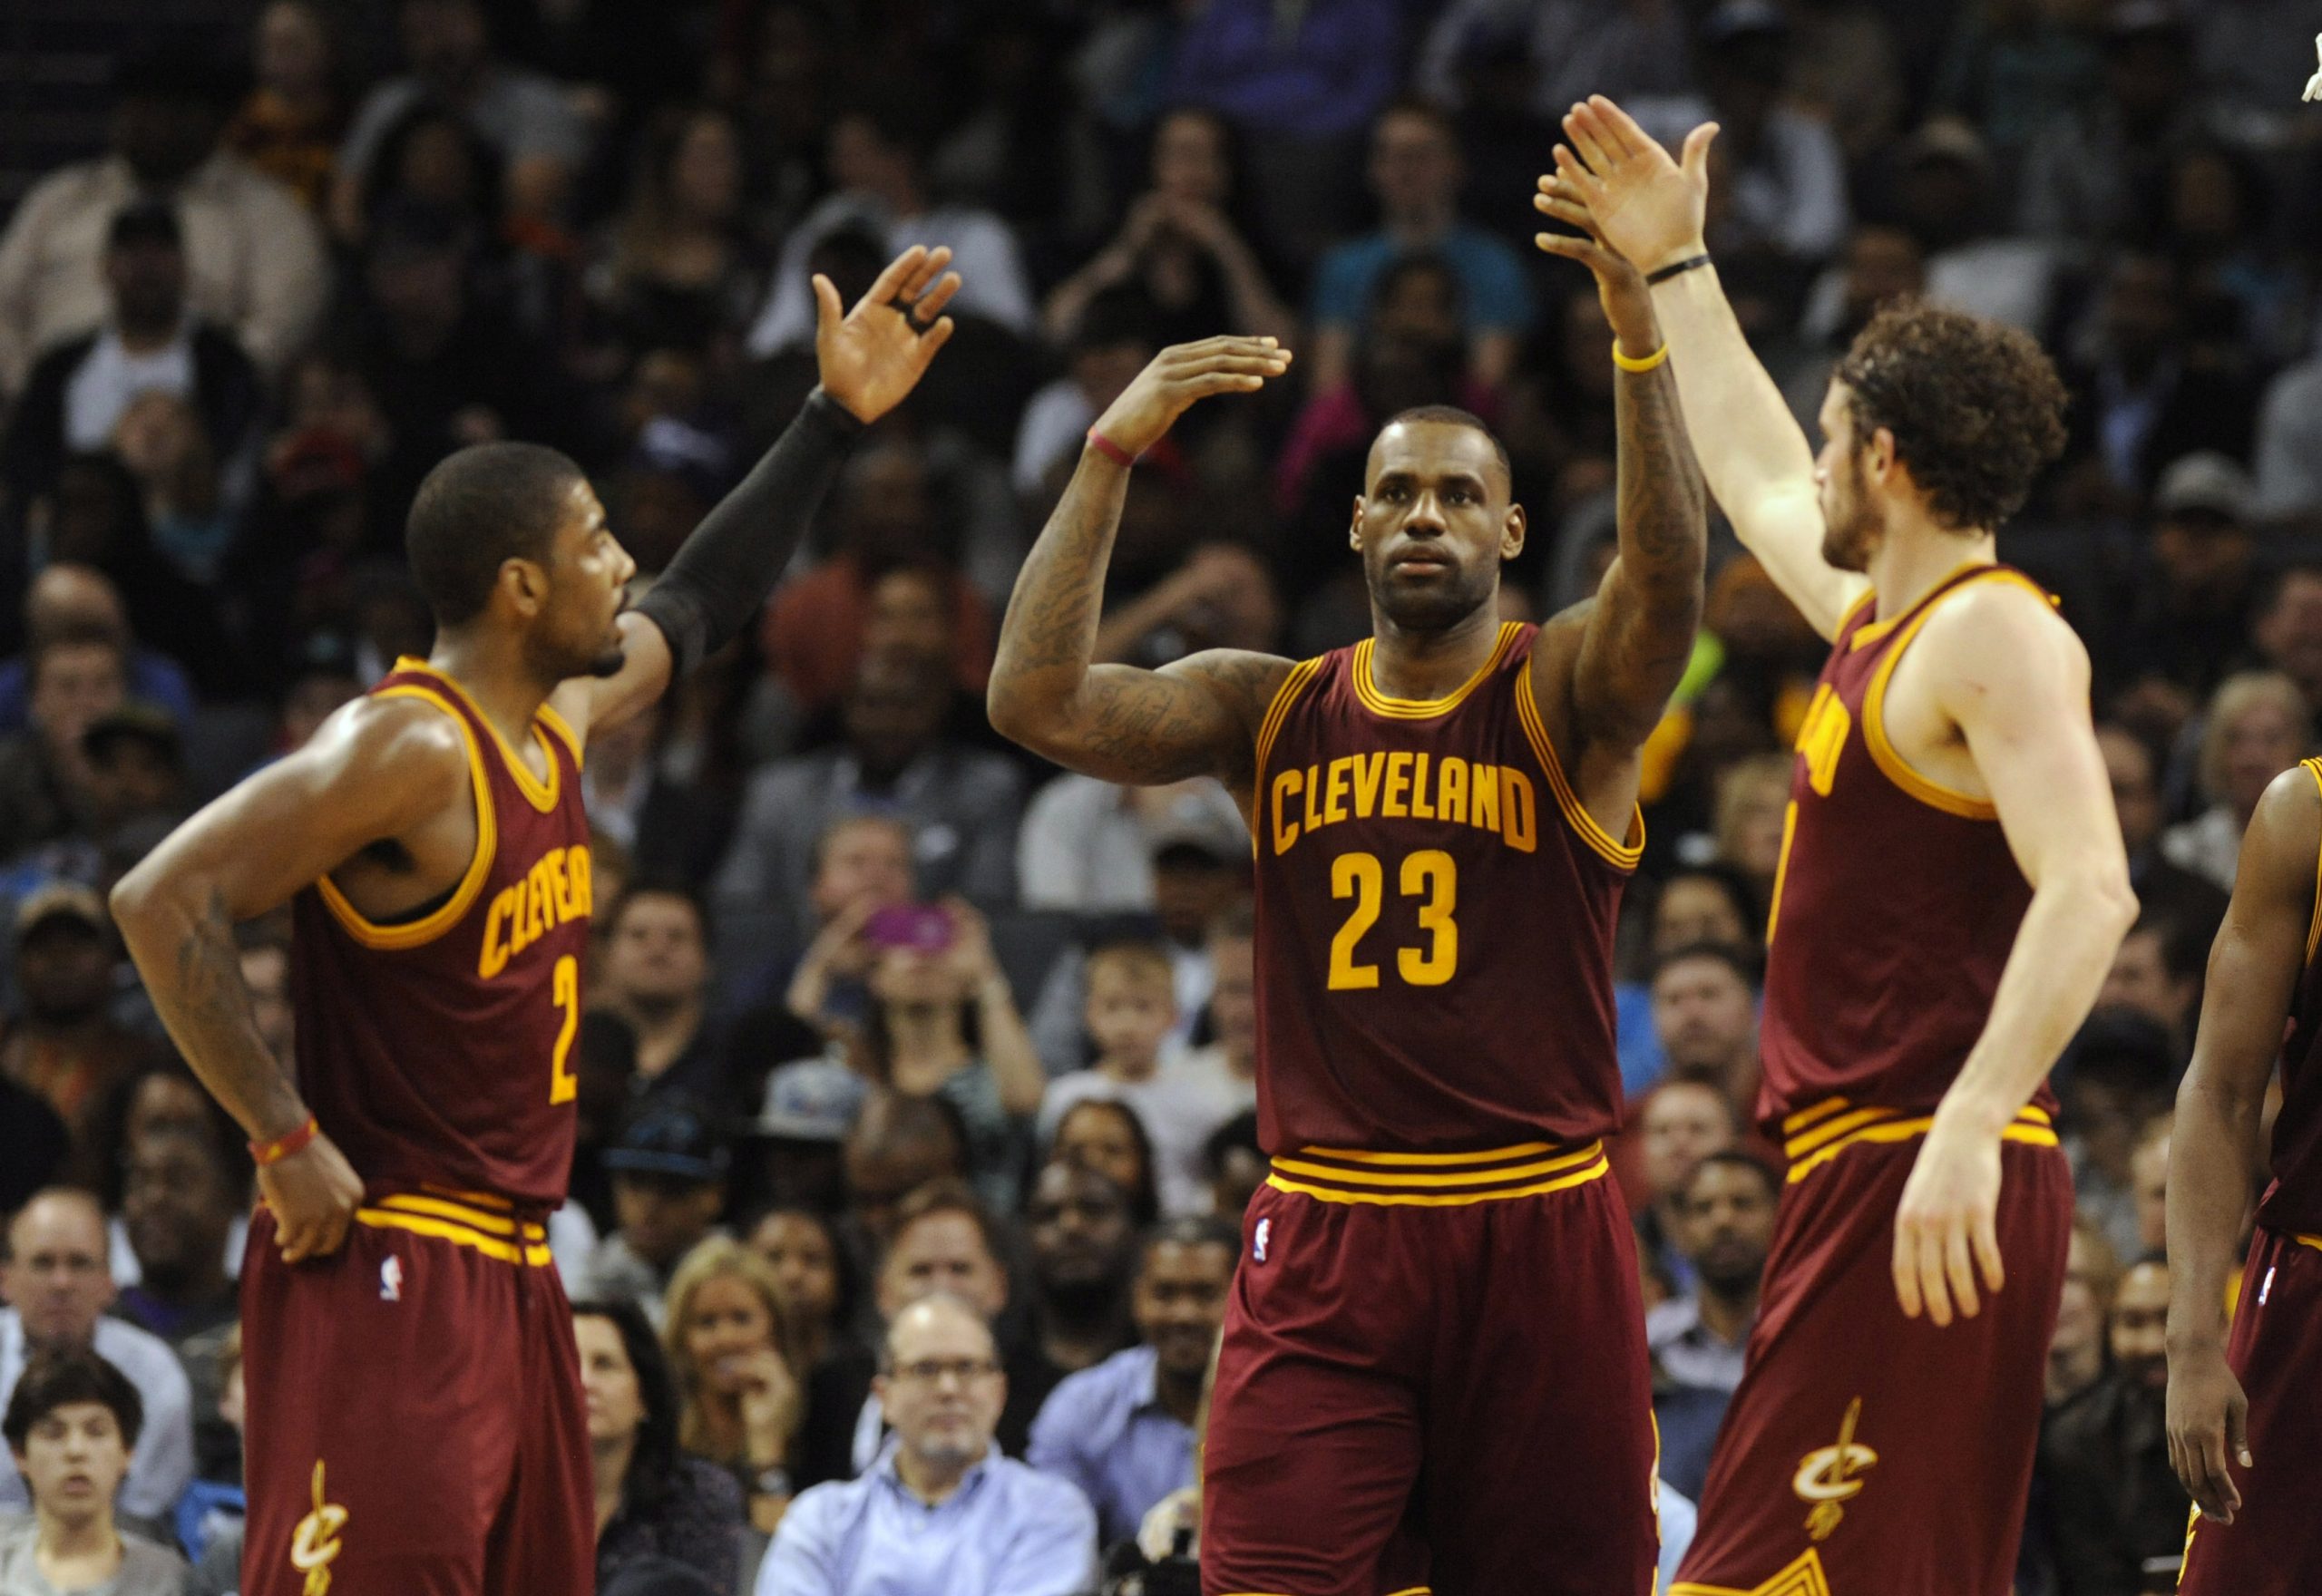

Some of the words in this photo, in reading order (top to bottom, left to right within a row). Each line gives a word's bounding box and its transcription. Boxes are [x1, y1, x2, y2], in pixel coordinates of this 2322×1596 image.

[1272, 751, 1537, 855] CLEVELAND
[1327, 850, 1459, 990] 23
[550, 954, 578, 1105] 2
